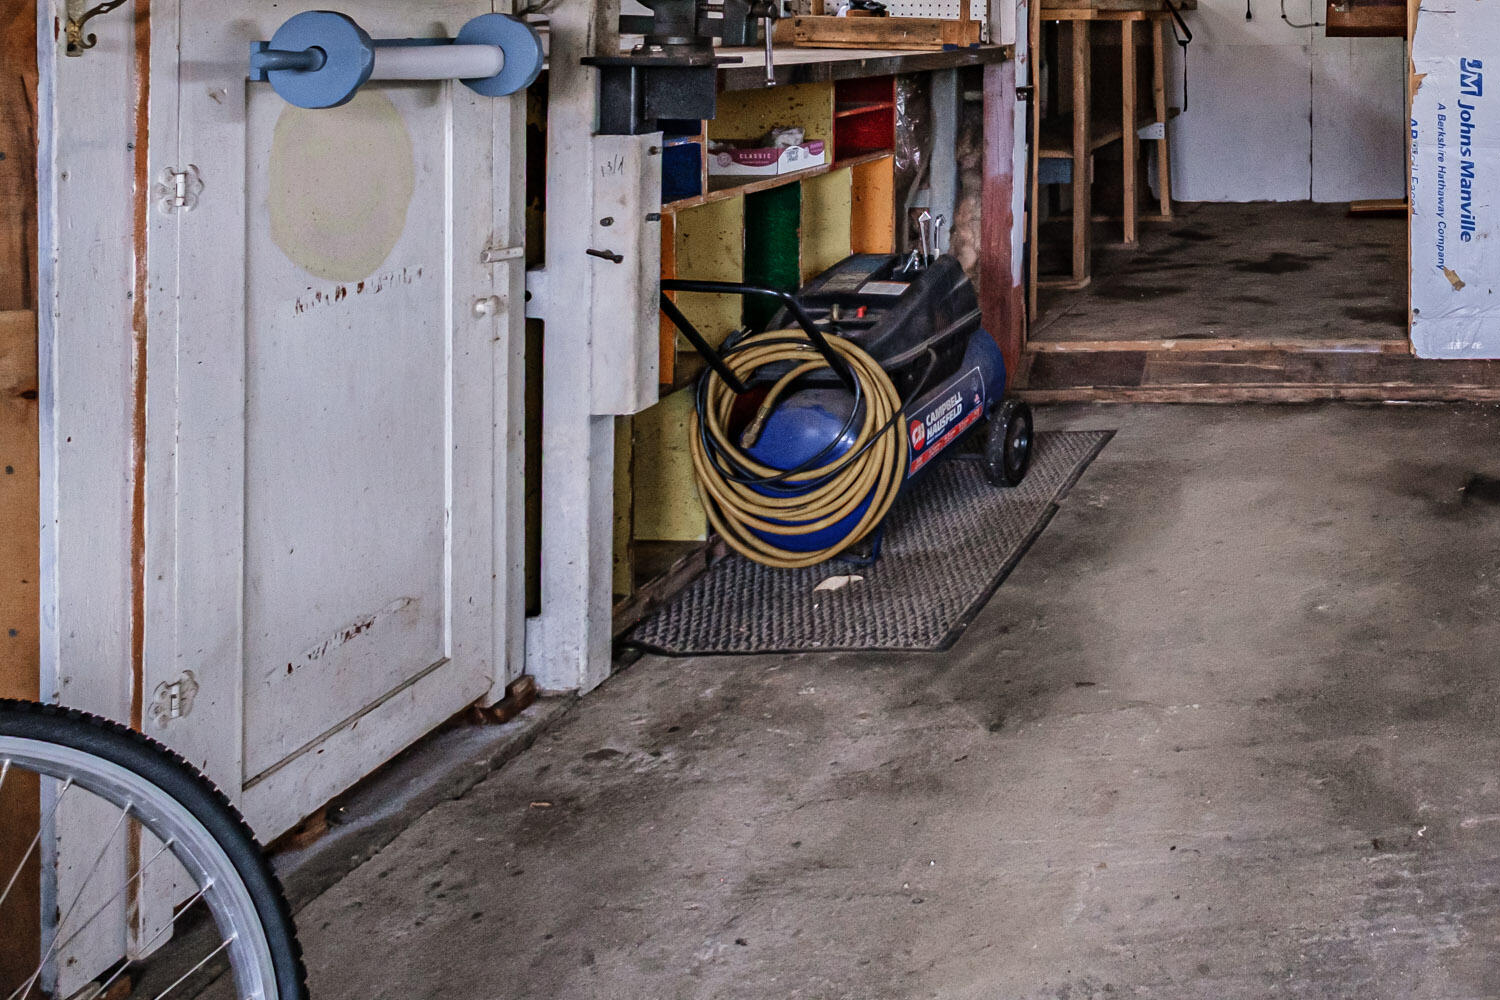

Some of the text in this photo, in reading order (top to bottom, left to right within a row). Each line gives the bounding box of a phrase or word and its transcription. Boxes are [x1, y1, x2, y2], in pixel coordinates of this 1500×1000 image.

[1436, 103, 1447, 270] A Berkshire Hathaway Company
[1458, 99, 1476, 243] Johns Manville
[926, 391, 963, 427] CAMPBELL
[926, 403, 963, 441] HAUSFELD
